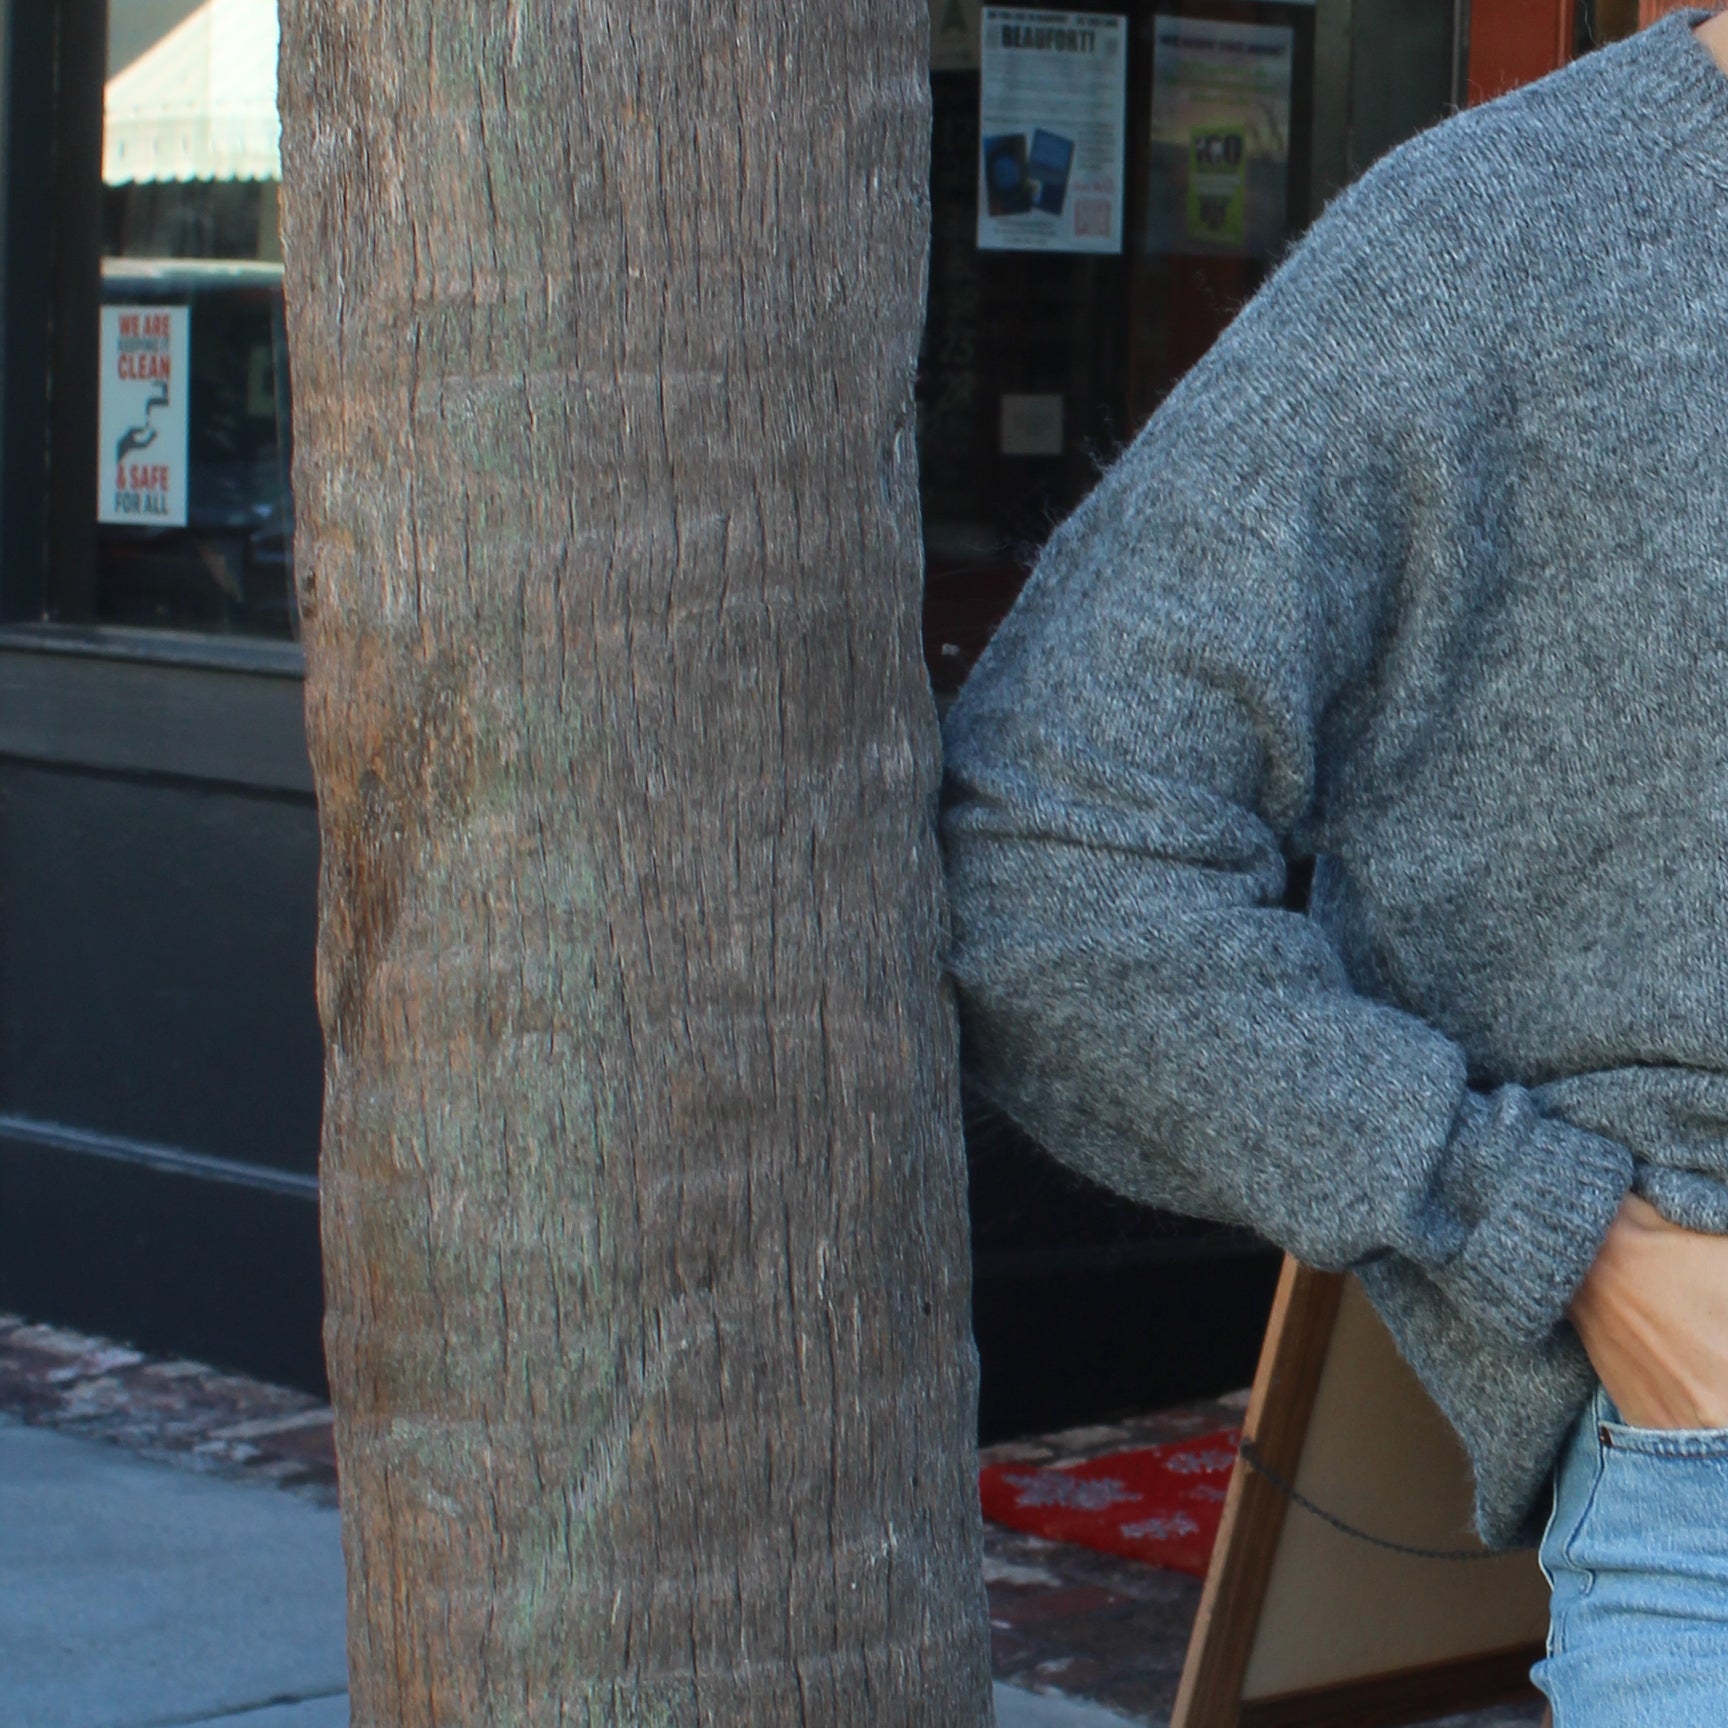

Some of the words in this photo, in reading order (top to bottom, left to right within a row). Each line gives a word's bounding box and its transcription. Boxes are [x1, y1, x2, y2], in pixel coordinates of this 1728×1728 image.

[118, 314, 140, 336] WE
[143, 314, 170, 337] ARE
[118, 353, 171, 380] CLEAN
[130, 465, 169, 492] SAFE
[114, 491, 140, 514] FOR
[142, 492, 169, 515] ALL
